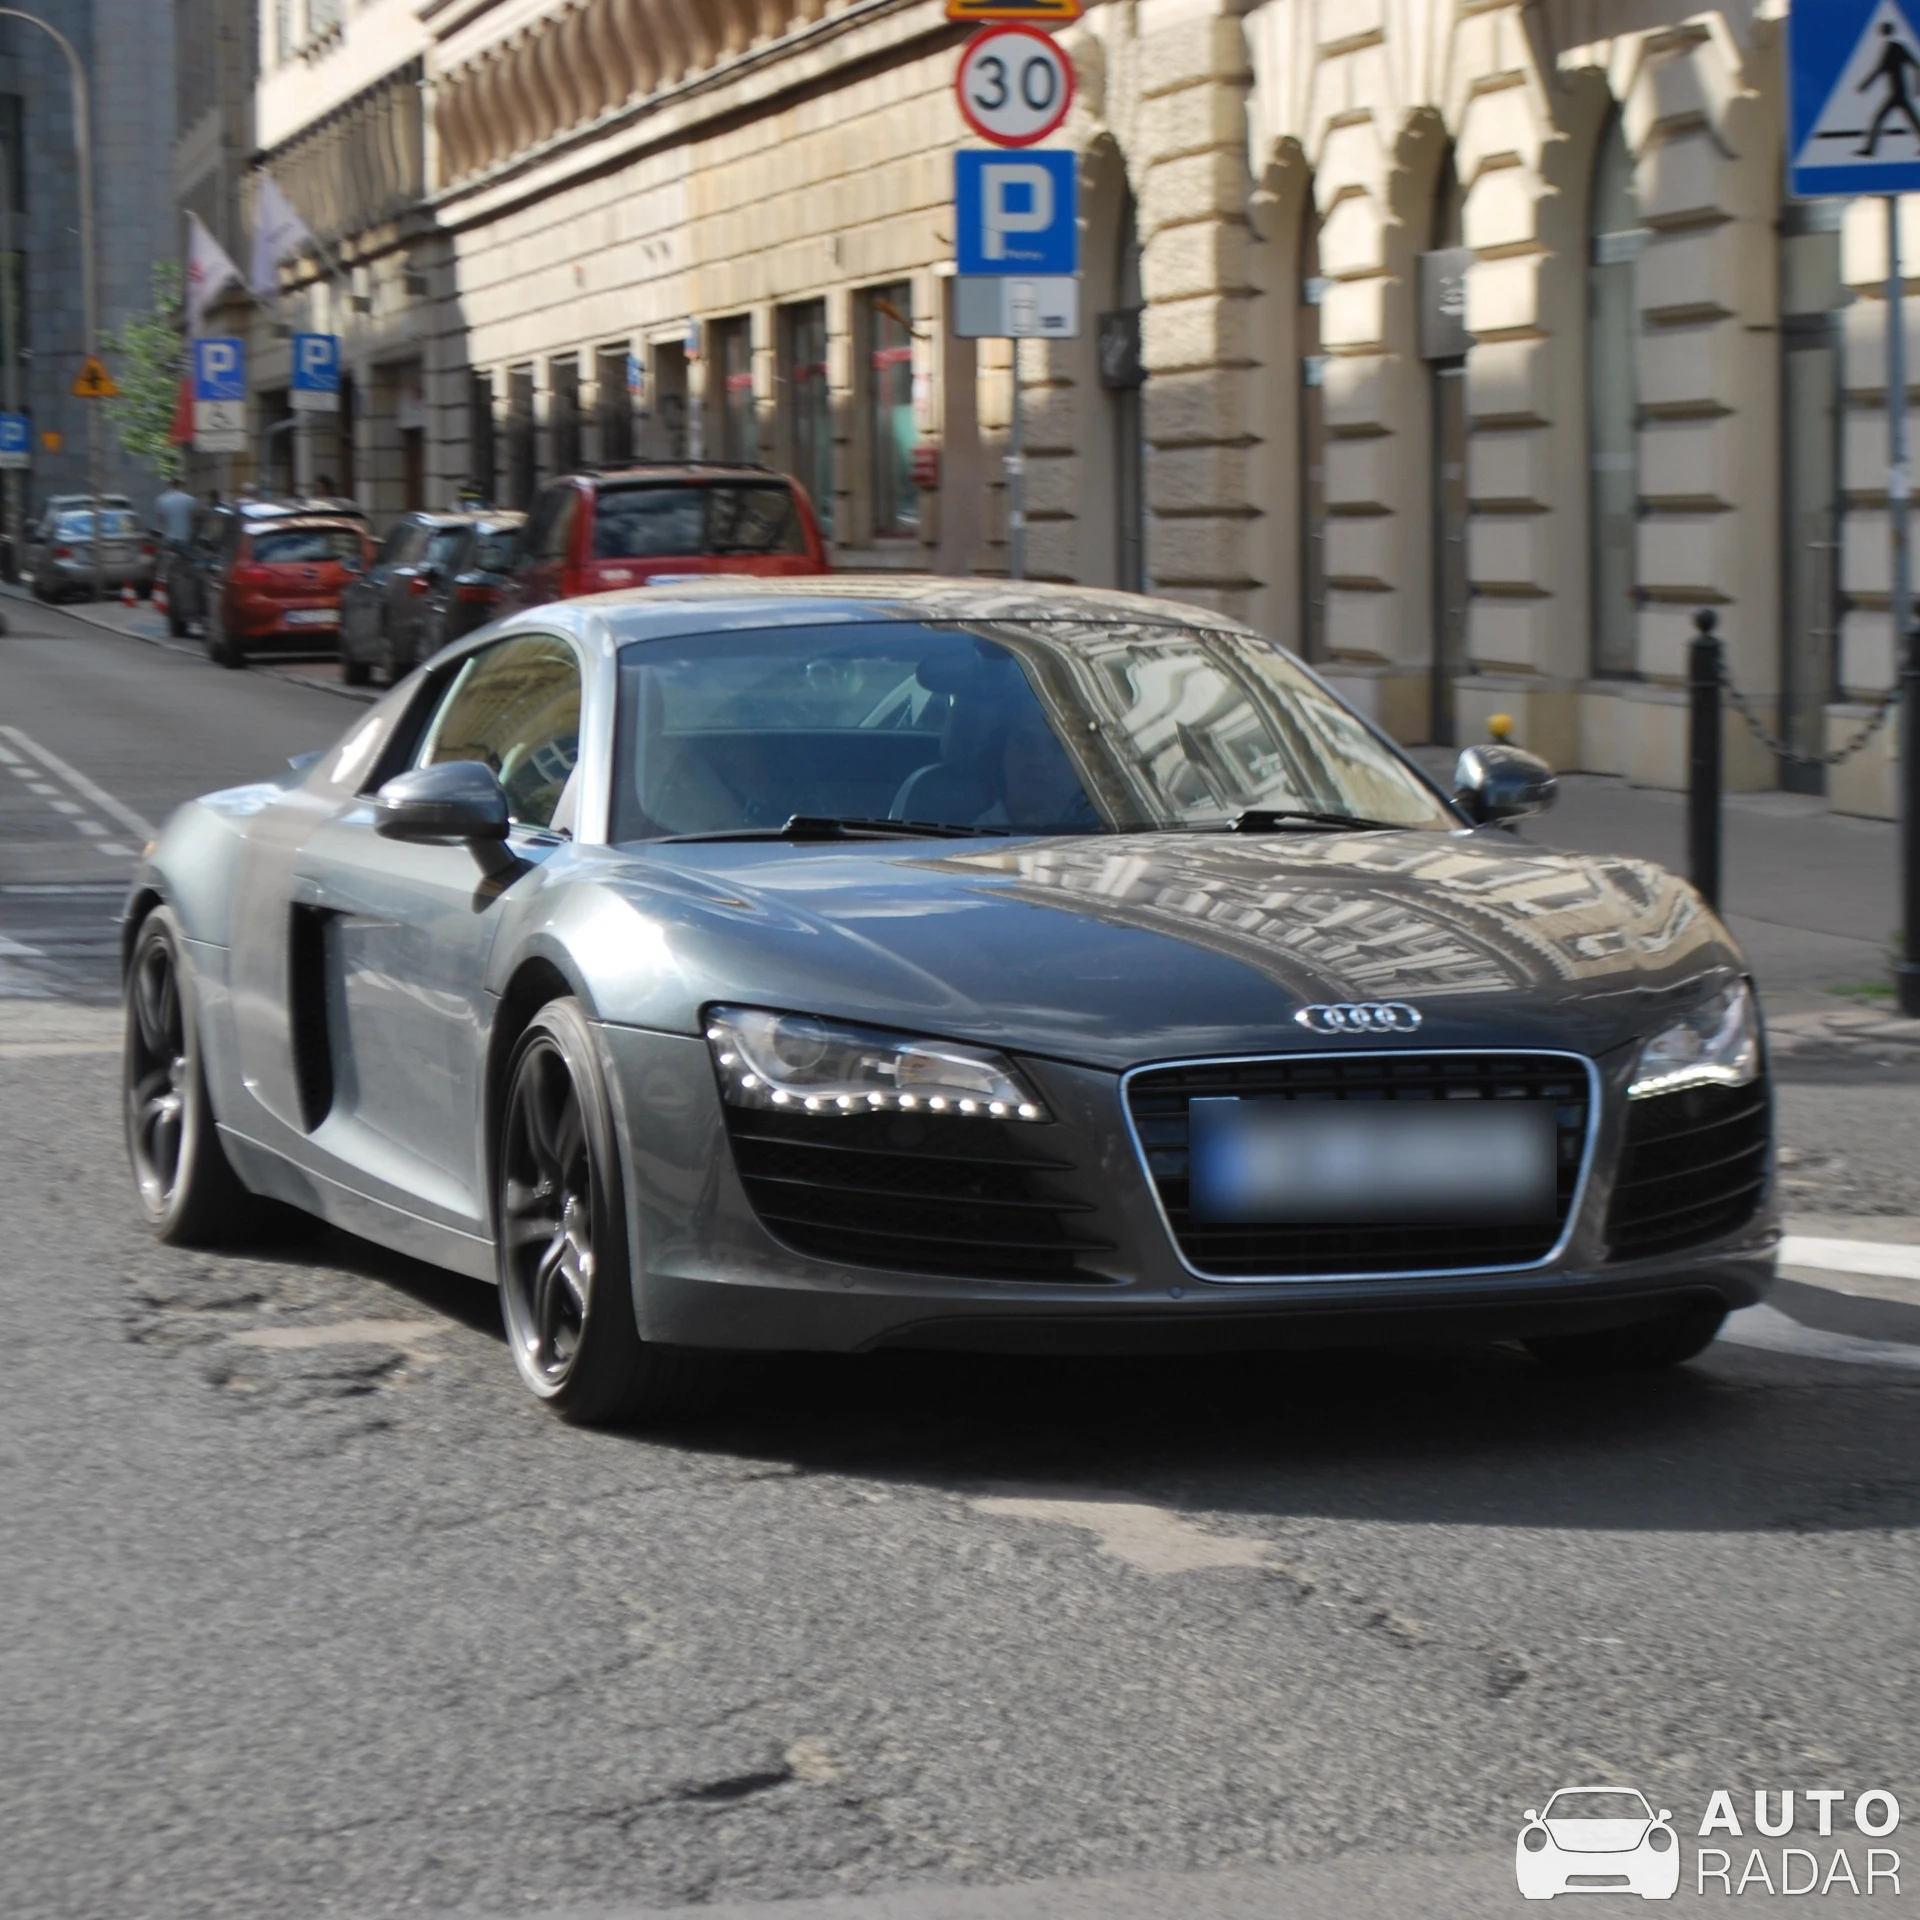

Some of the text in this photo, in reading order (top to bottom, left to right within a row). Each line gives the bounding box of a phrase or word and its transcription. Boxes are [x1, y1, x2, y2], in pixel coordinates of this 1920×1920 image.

[974, 56, 1058, 111] 30
[981, 164, 1054, 260] P
[202, 343, 235, 382] P
[302, 338, 331, 376] P
